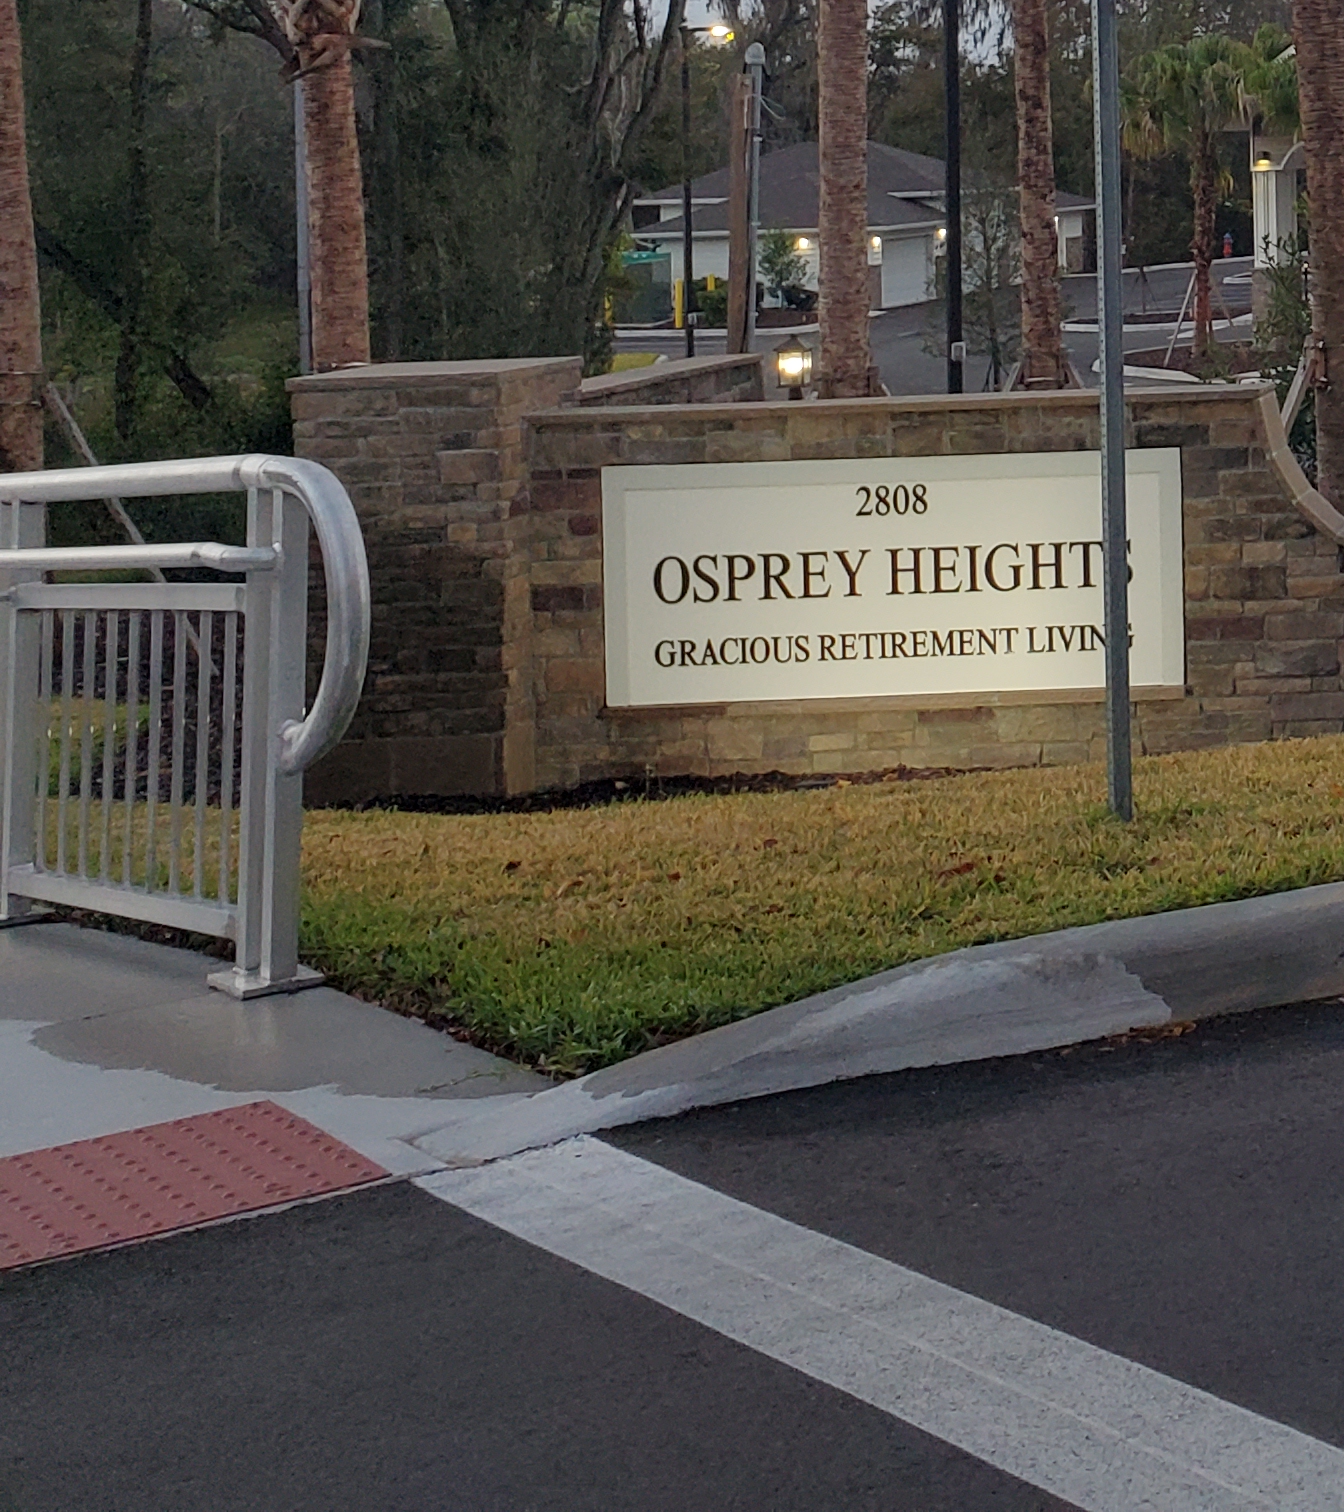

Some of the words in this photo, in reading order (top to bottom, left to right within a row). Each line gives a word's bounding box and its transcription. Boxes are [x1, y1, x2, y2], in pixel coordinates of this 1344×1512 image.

[855, 483, 928, 517] 2808
[652, 548, 871, 604] OSPREY
[884, 538, 1134, 596] HEIGHT
[654, 634, 810, 668] GRACIOUS
[817, 626, 1019, 662] RETIREMENT
[1025, 622, 1136, 655] LIVIN
